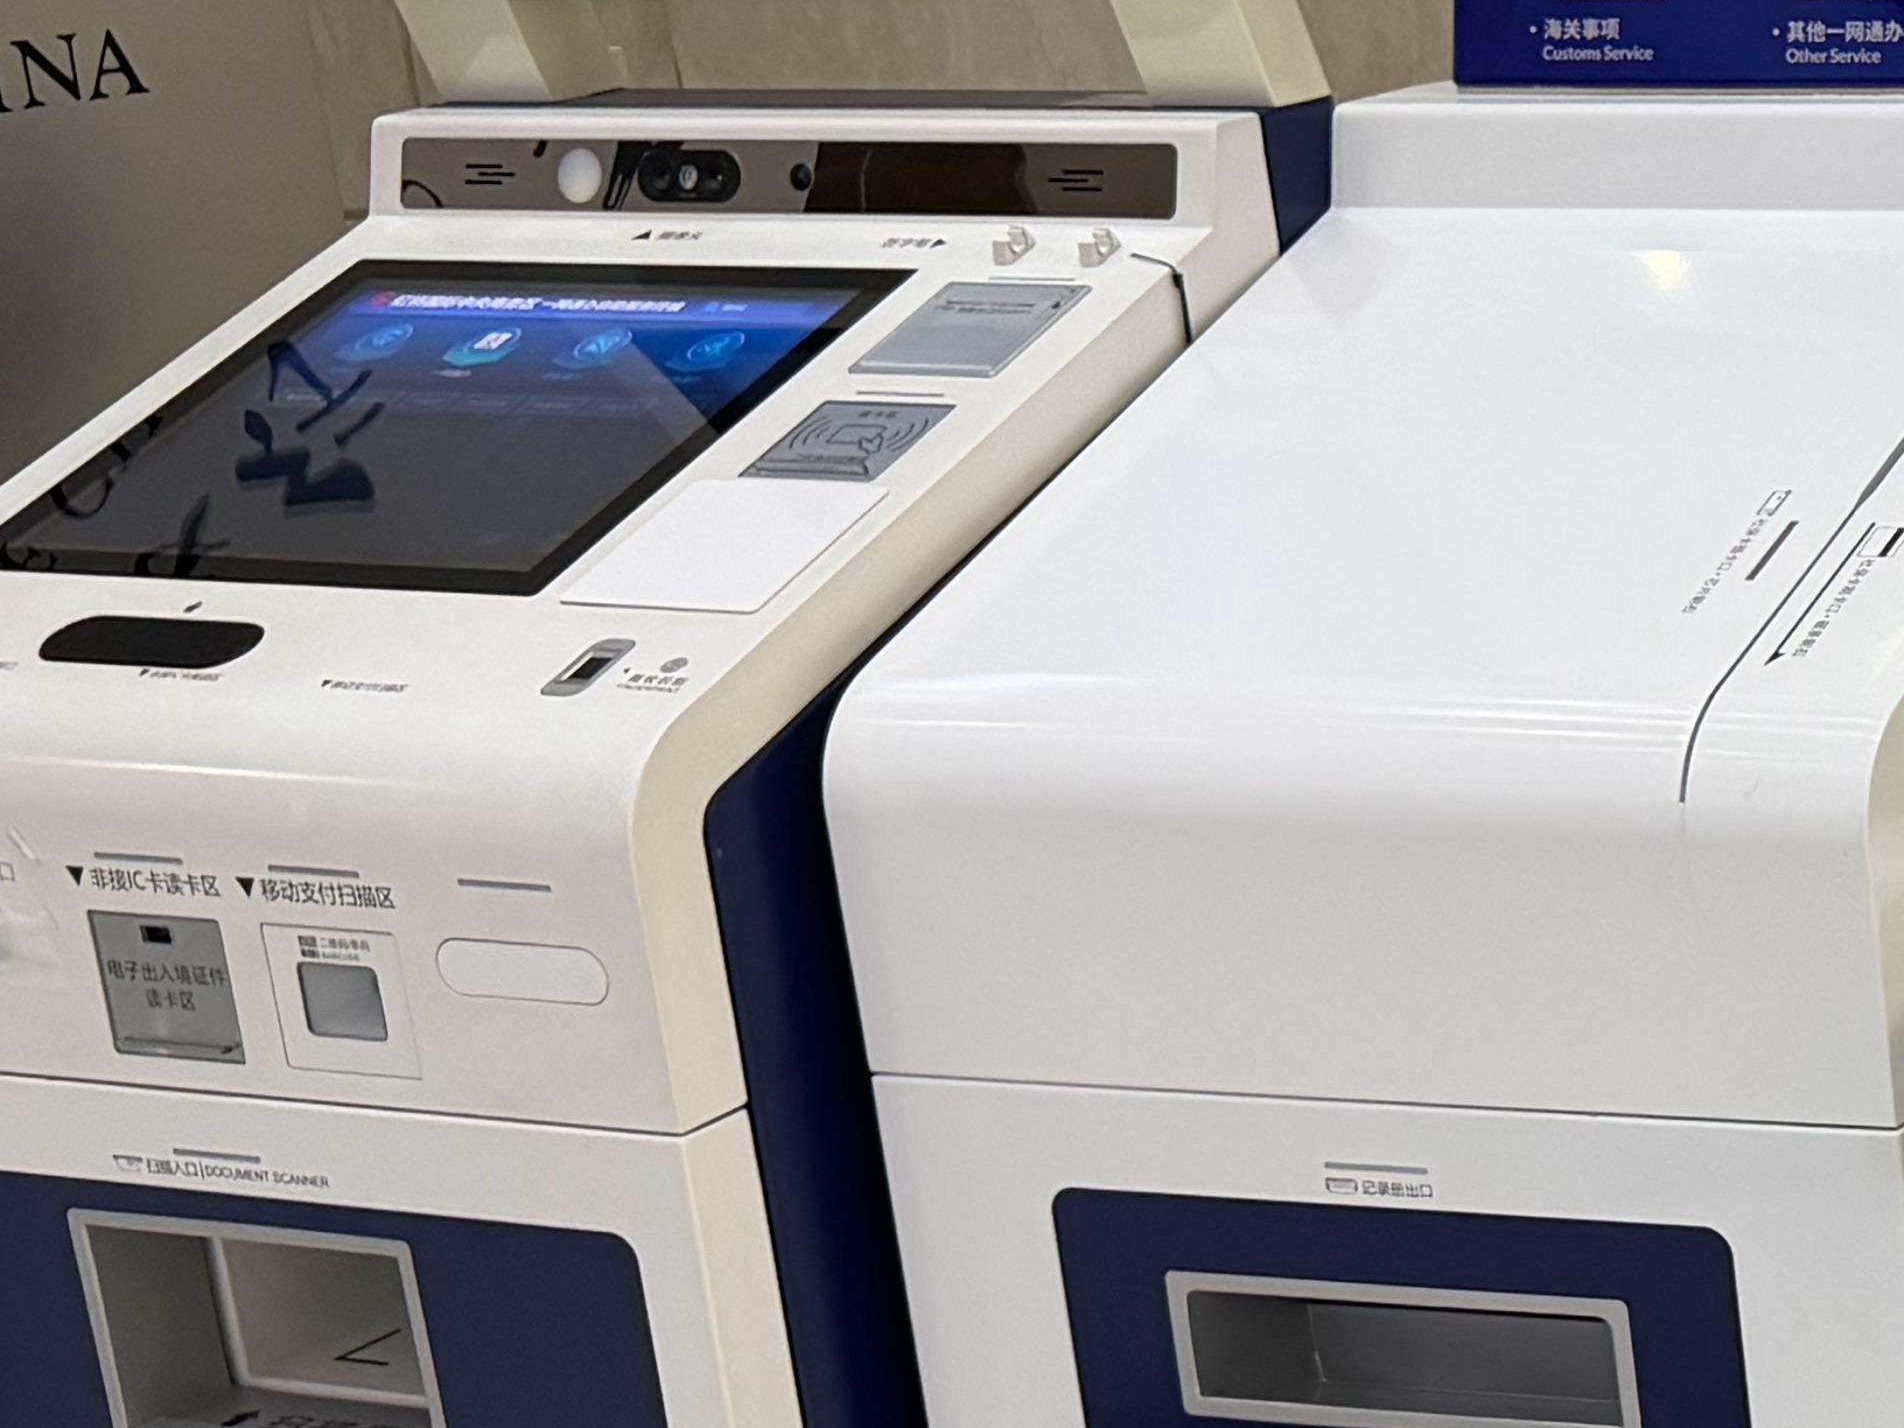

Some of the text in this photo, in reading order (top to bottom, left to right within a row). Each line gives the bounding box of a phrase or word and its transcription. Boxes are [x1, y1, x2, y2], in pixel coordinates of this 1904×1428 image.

[1543, 17, 1621, 41] 海关事项
[1541, 44, 1654, 62] Customs Service
[1785, 46, 1882, 64] Other Service
[88, 866, 222, 897] 非接IC卡读卡区
[259, 878, 396, 909] 移动支付扫描区
